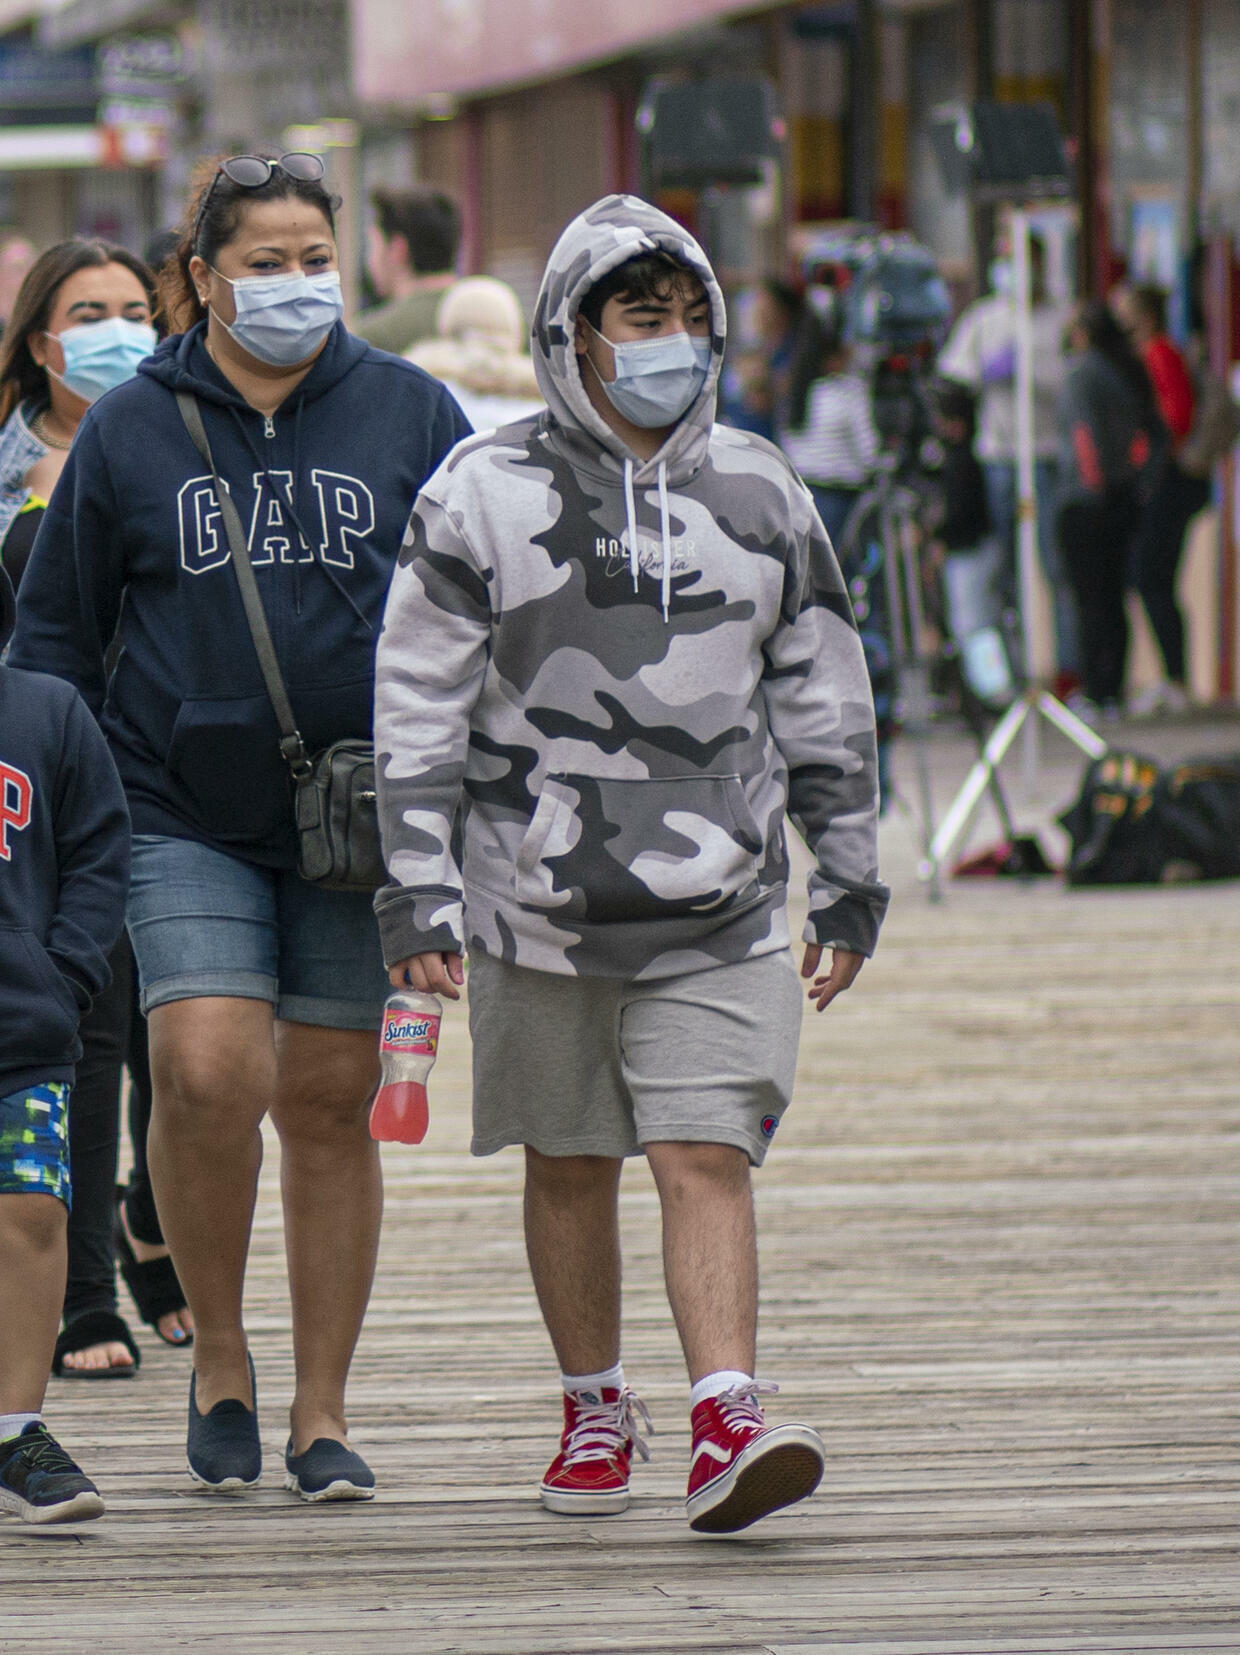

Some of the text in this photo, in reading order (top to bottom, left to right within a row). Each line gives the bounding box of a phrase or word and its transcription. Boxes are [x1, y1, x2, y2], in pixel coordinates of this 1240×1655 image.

[177, 468, 375, 575] GAP
[596, 537, 696, 558] HOLISER
[384, 1020, 431, 1042] Sunkist
